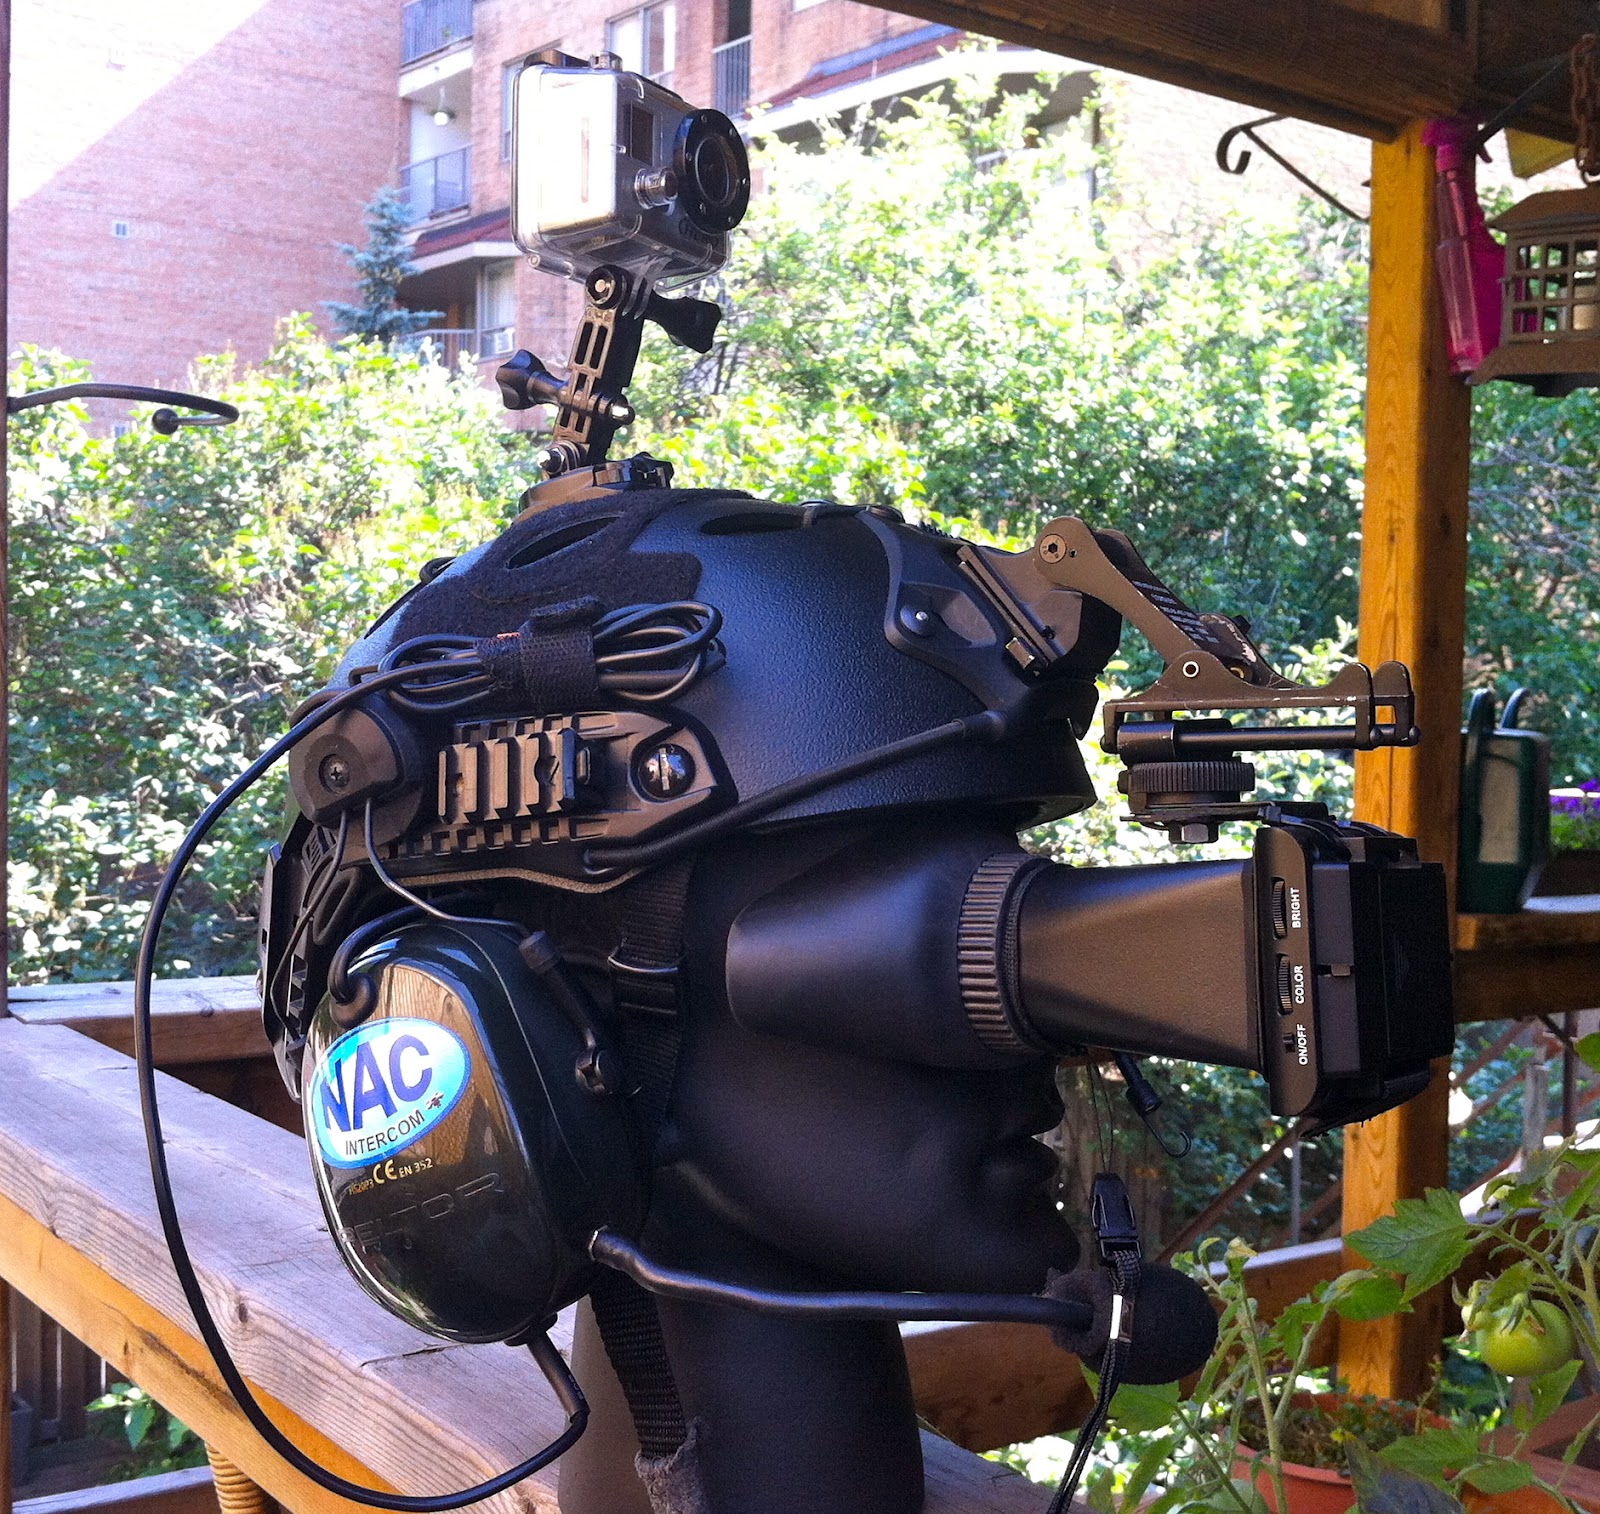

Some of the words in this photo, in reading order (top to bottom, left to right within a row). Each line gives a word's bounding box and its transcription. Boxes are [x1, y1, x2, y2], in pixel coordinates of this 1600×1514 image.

[1290, 887, 1302, 929] BRIGHT
[1294, 965, 1305, 1004] COLOR
[1296, 1023, 1308, 1066] ON/OFF
[319, 1034, 433, 1132] NAC
[345, 1109, 425, 1156] INTERCOM
[398, 1165, 413, 1178] EN
[413, 1157, 433, 1173] 352
